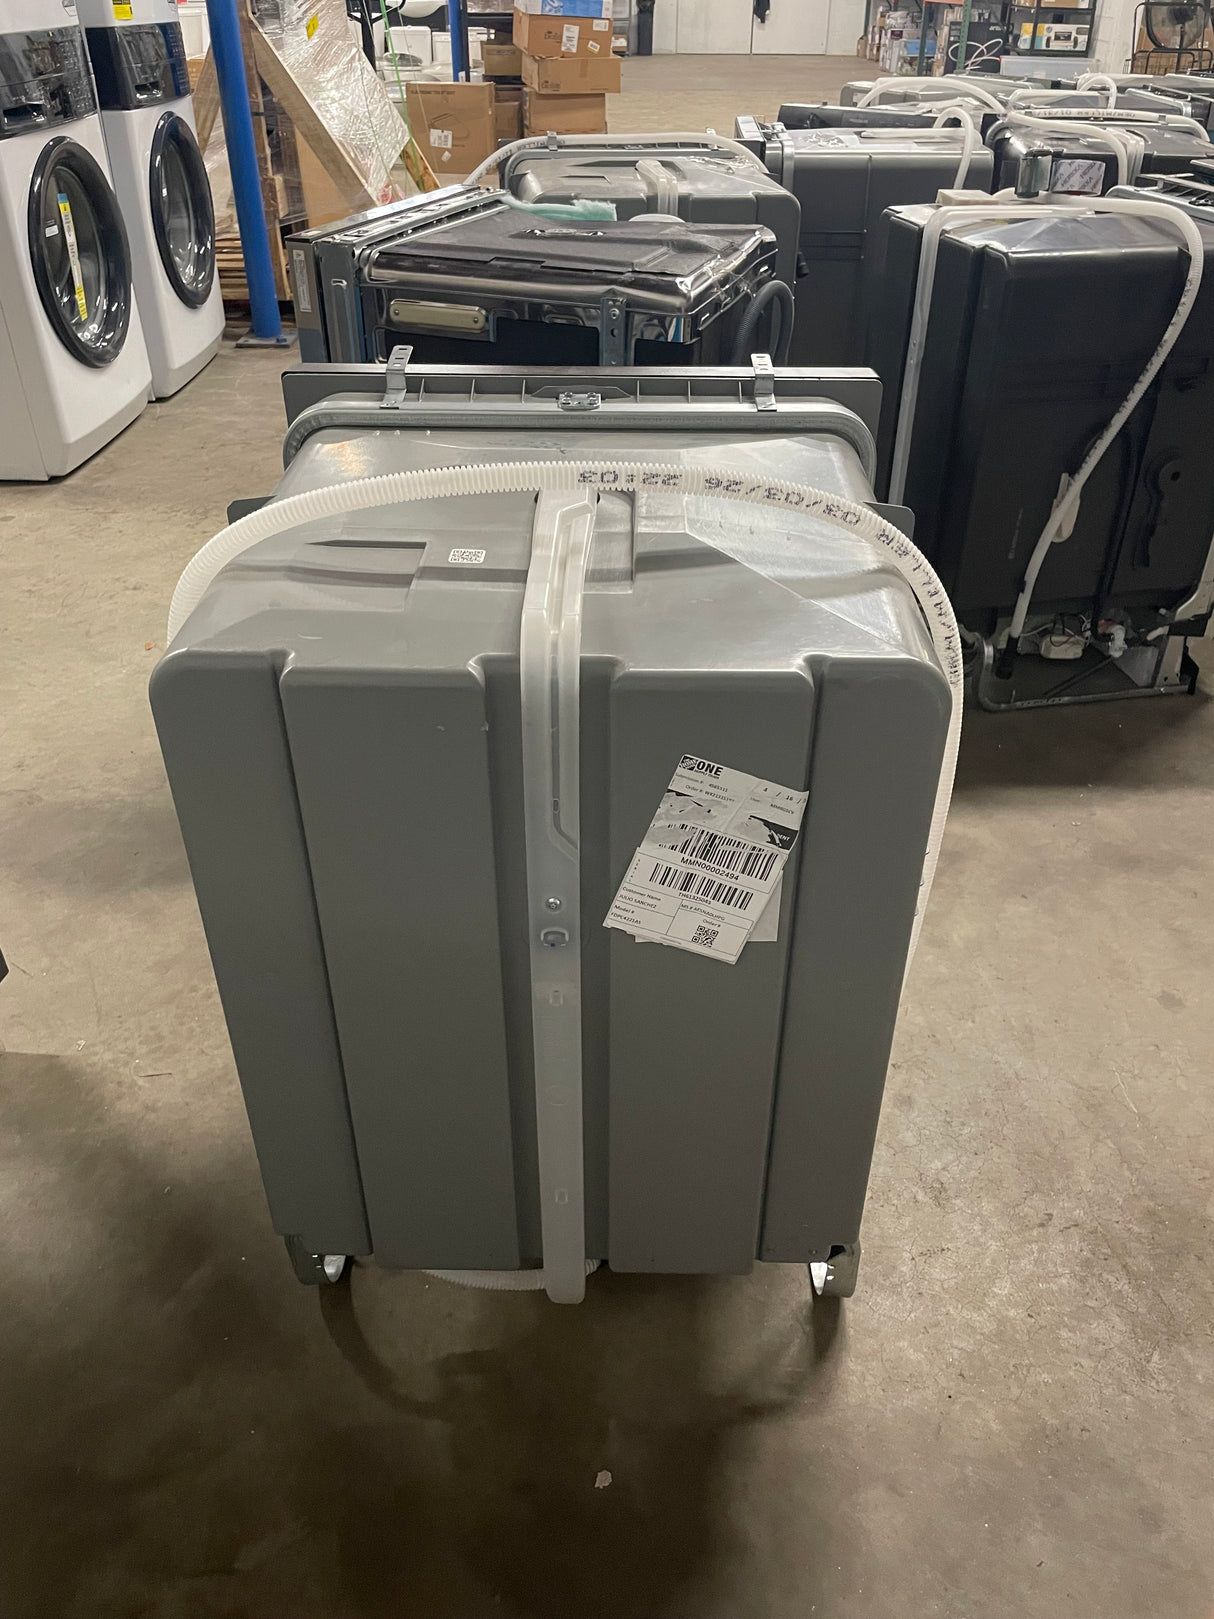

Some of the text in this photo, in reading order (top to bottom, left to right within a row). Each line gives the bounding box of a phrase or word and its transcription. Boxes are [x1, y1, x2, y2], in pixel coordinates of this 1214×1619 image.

[696, 760, 723, 776] ONE
[680, 857, 739, 881] MMN00002494
[623, 887, 645, 896] Customer
[633, 899, 656, 908] SANCHEZ
[615, 905, 630, 913] Model
